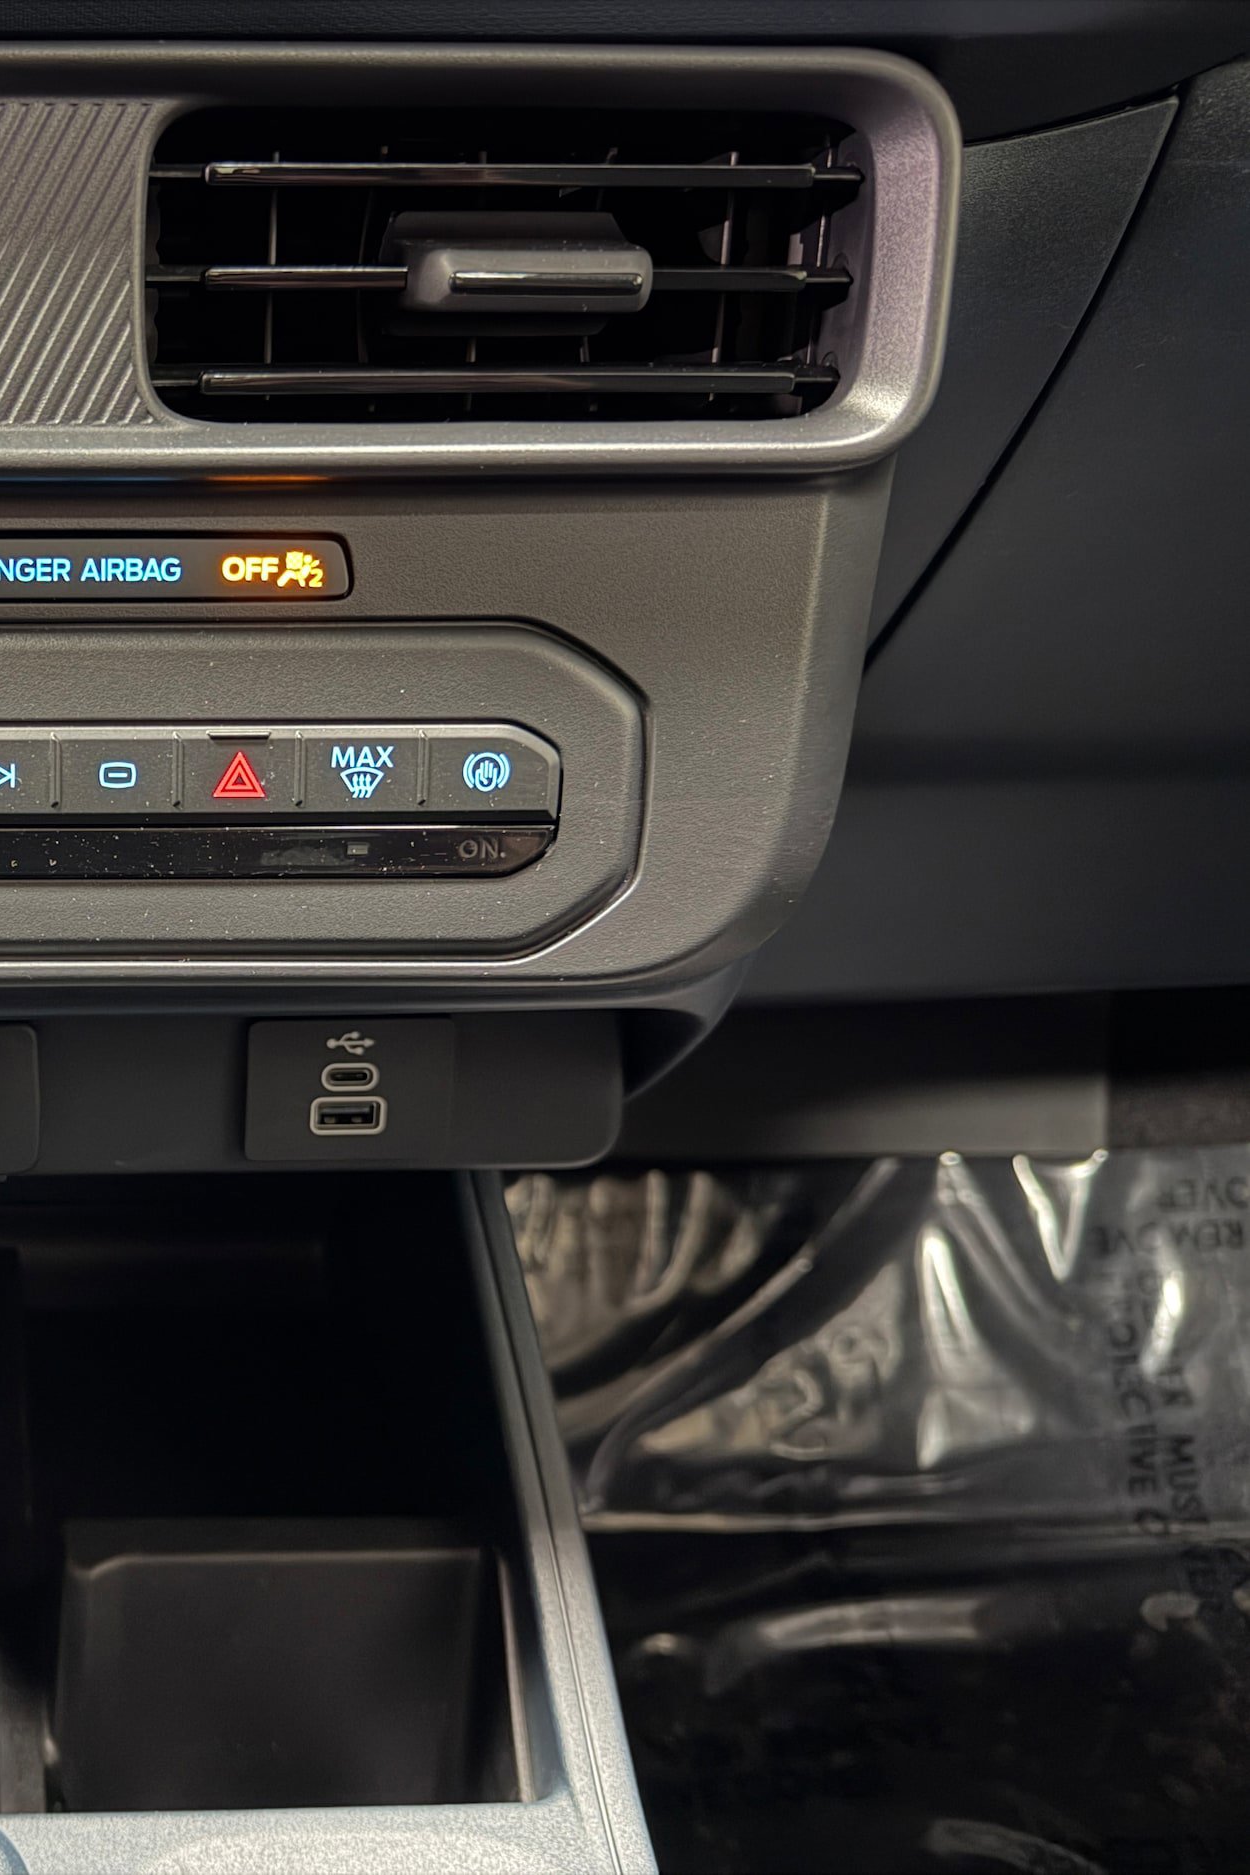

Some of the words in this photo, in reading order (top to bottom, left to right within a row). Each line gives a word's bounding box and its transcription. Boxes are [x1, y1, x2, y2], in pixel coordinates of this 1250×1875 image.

[80, 556, 182, 582] AIRBAG
[221, 556, 279, 581] OFF
[331, 746, 394, 769] MAX
